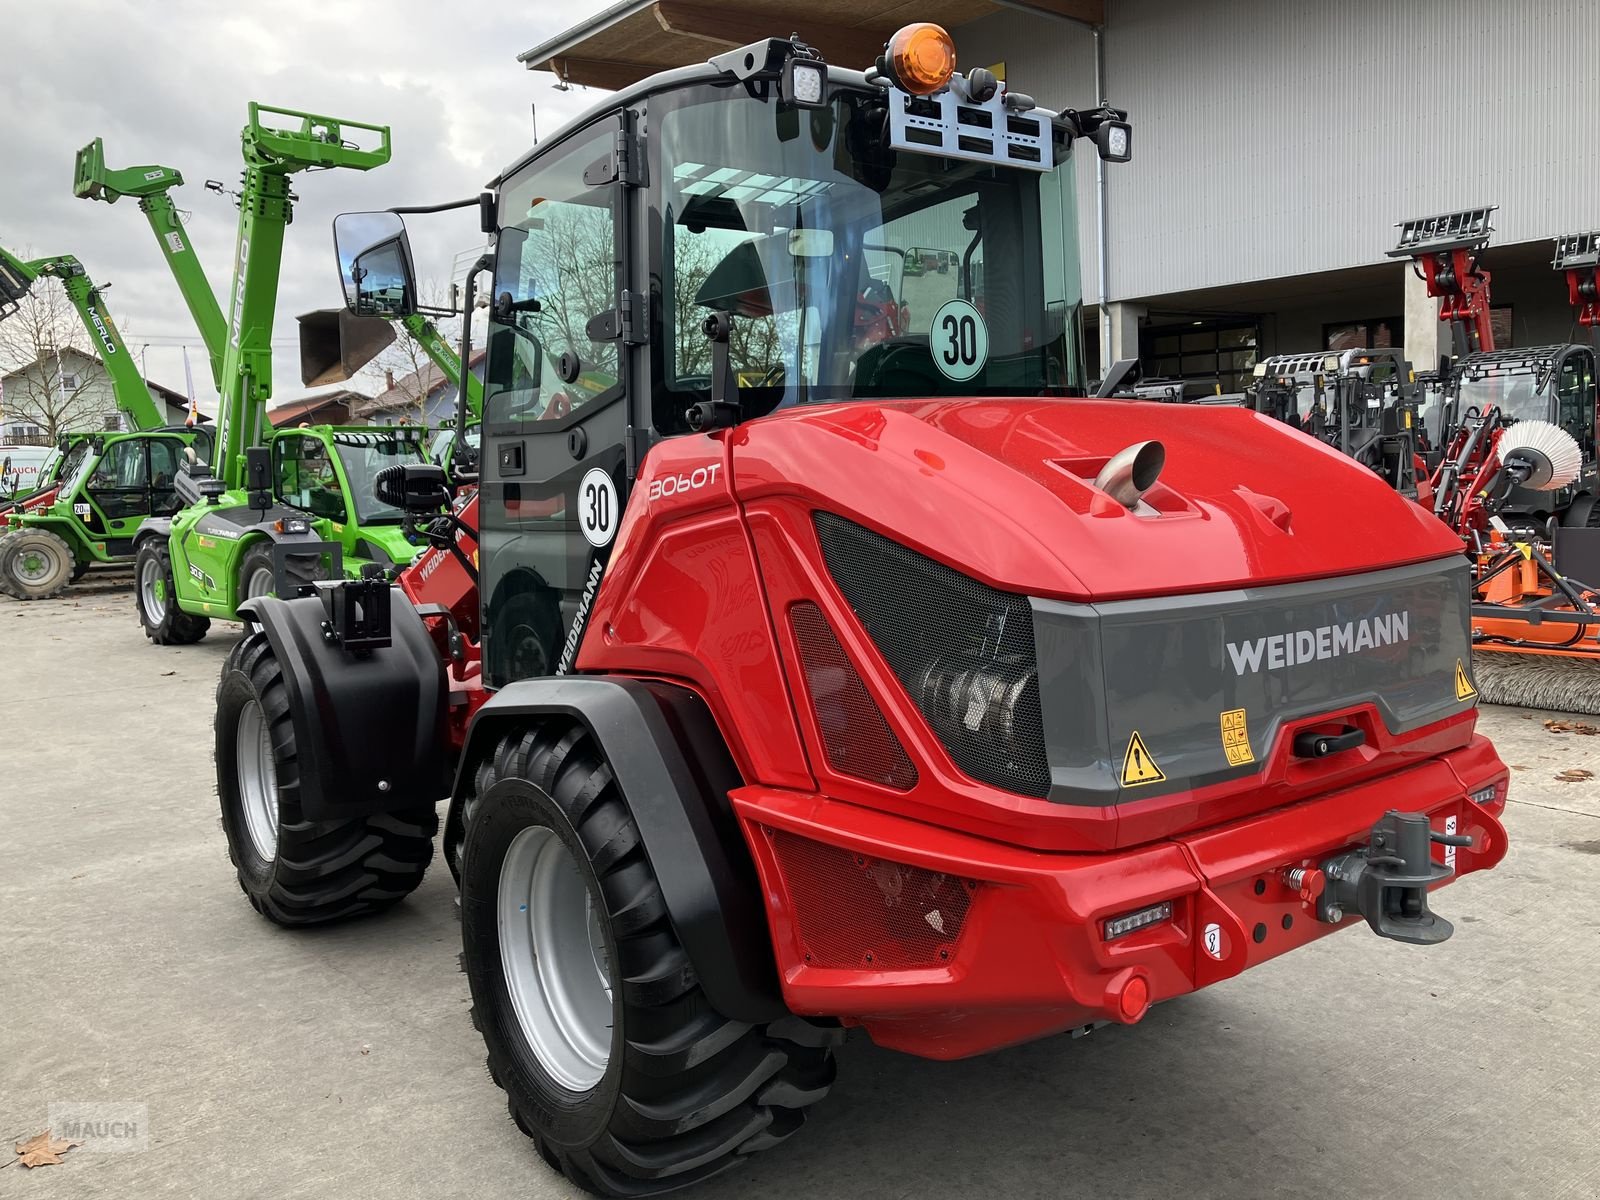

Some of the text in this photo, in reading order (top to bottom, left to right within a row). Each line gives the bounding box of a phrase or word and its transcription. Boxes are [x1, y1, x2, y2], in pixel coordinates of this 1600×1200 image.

[231, 239, 248, 347] MERLO
[87, 306, 116, 354] MERLO
[942, 314, 977, 366] 30
[649, 463, 721, 501] 3060T
[75, 504, 84, 514] 20
[586, 483, 609, 532] 30
[556, 557, 603, 676] WEIDEMANN
[1226, 611, 1409, 676] WEIDEMANN
